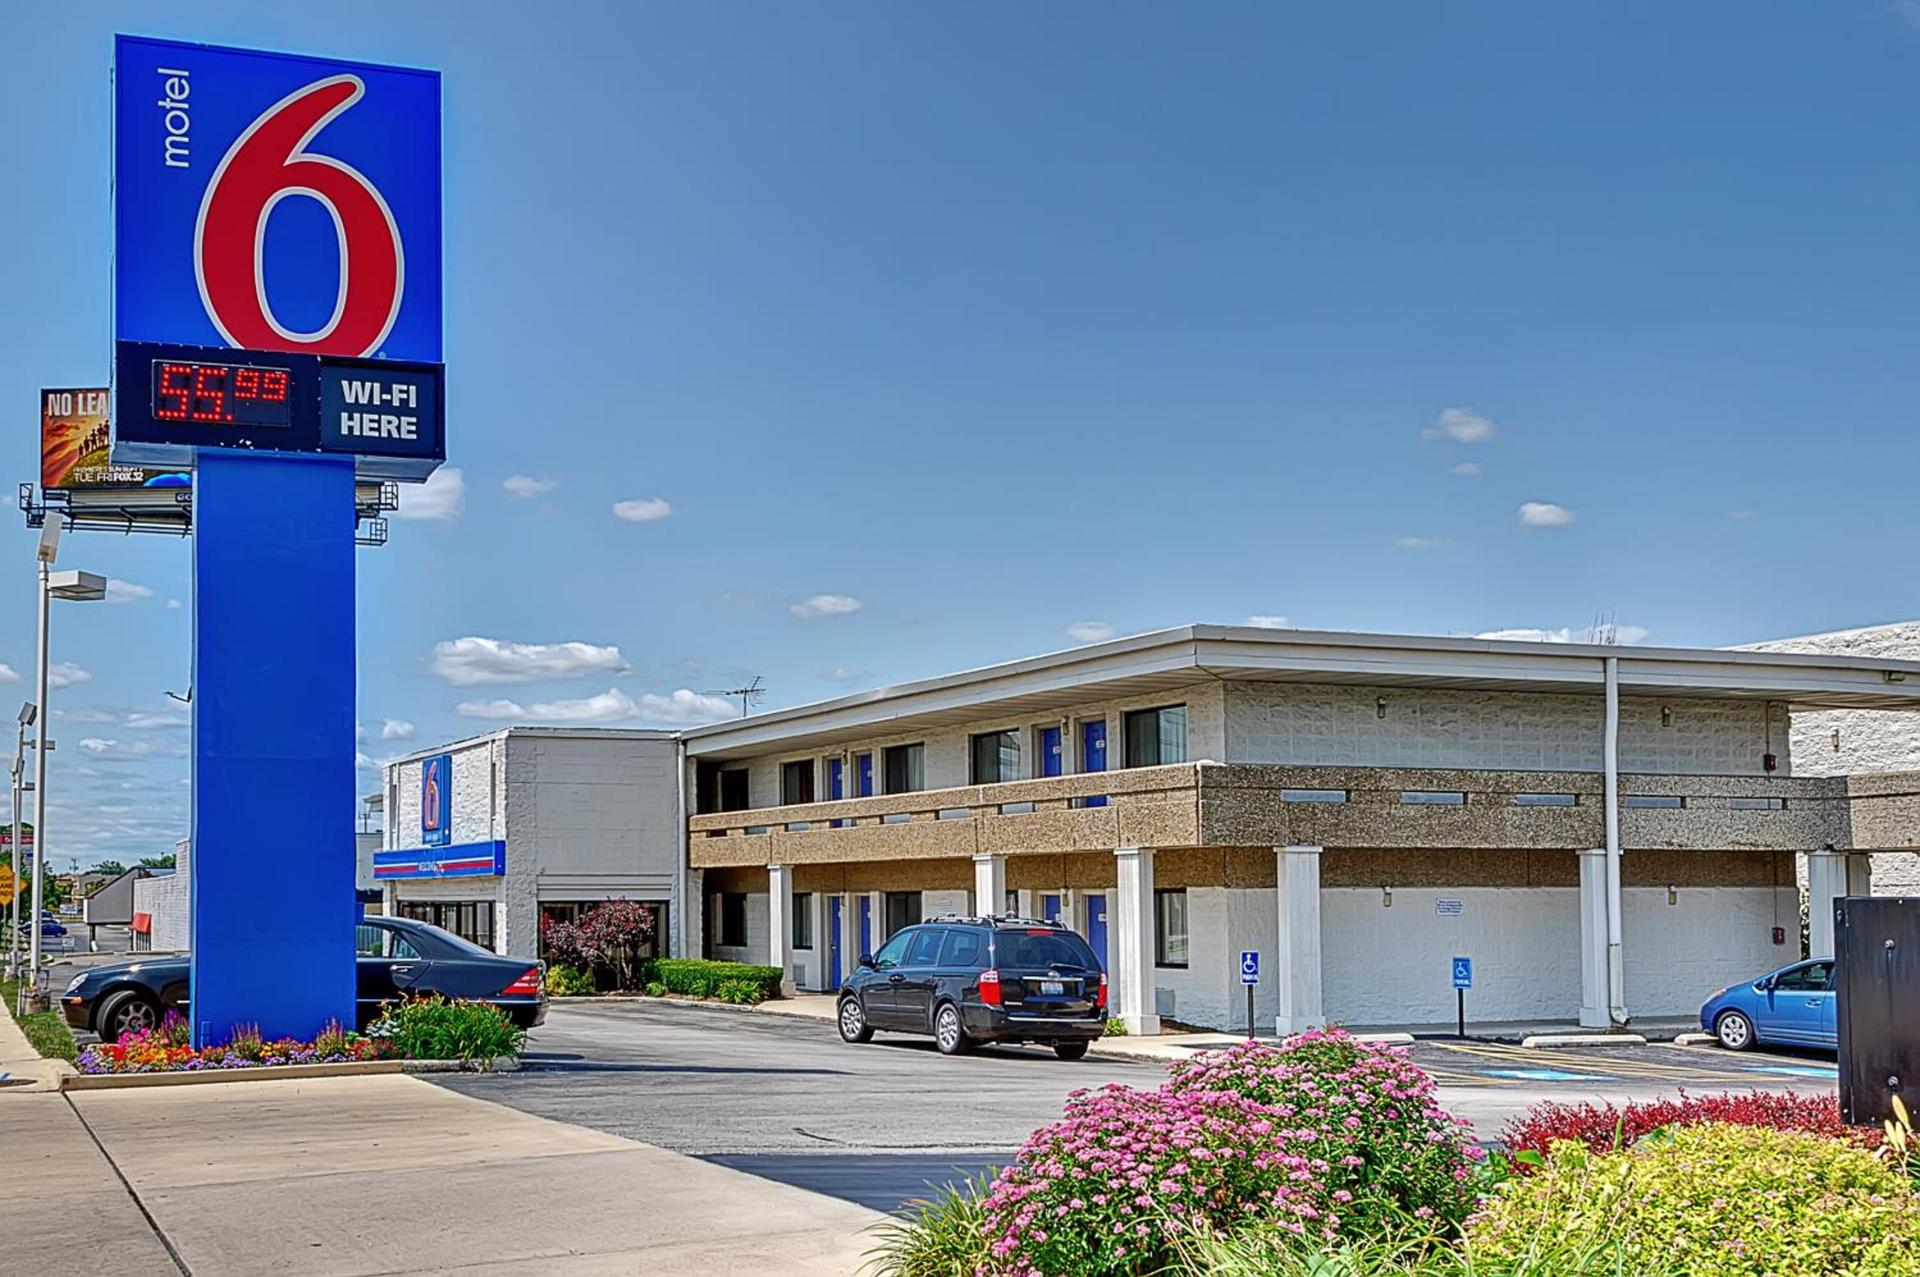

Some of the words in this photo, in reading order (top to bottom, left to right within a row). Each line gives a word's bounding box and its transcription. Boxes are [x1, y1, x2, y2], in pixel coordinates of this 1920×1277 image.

[157, 67, 190, 168] motel
[193, 73, 405, 358] 6
[48, 393, 72, 417] NO
[341, 380, 417, 408] WI-FI
[340, 412, 417, 439] HERE
[74, 472, 94, 482] TUE
[97, 472, 112, 482] FRI
[424, 761, 439, 829] 6
